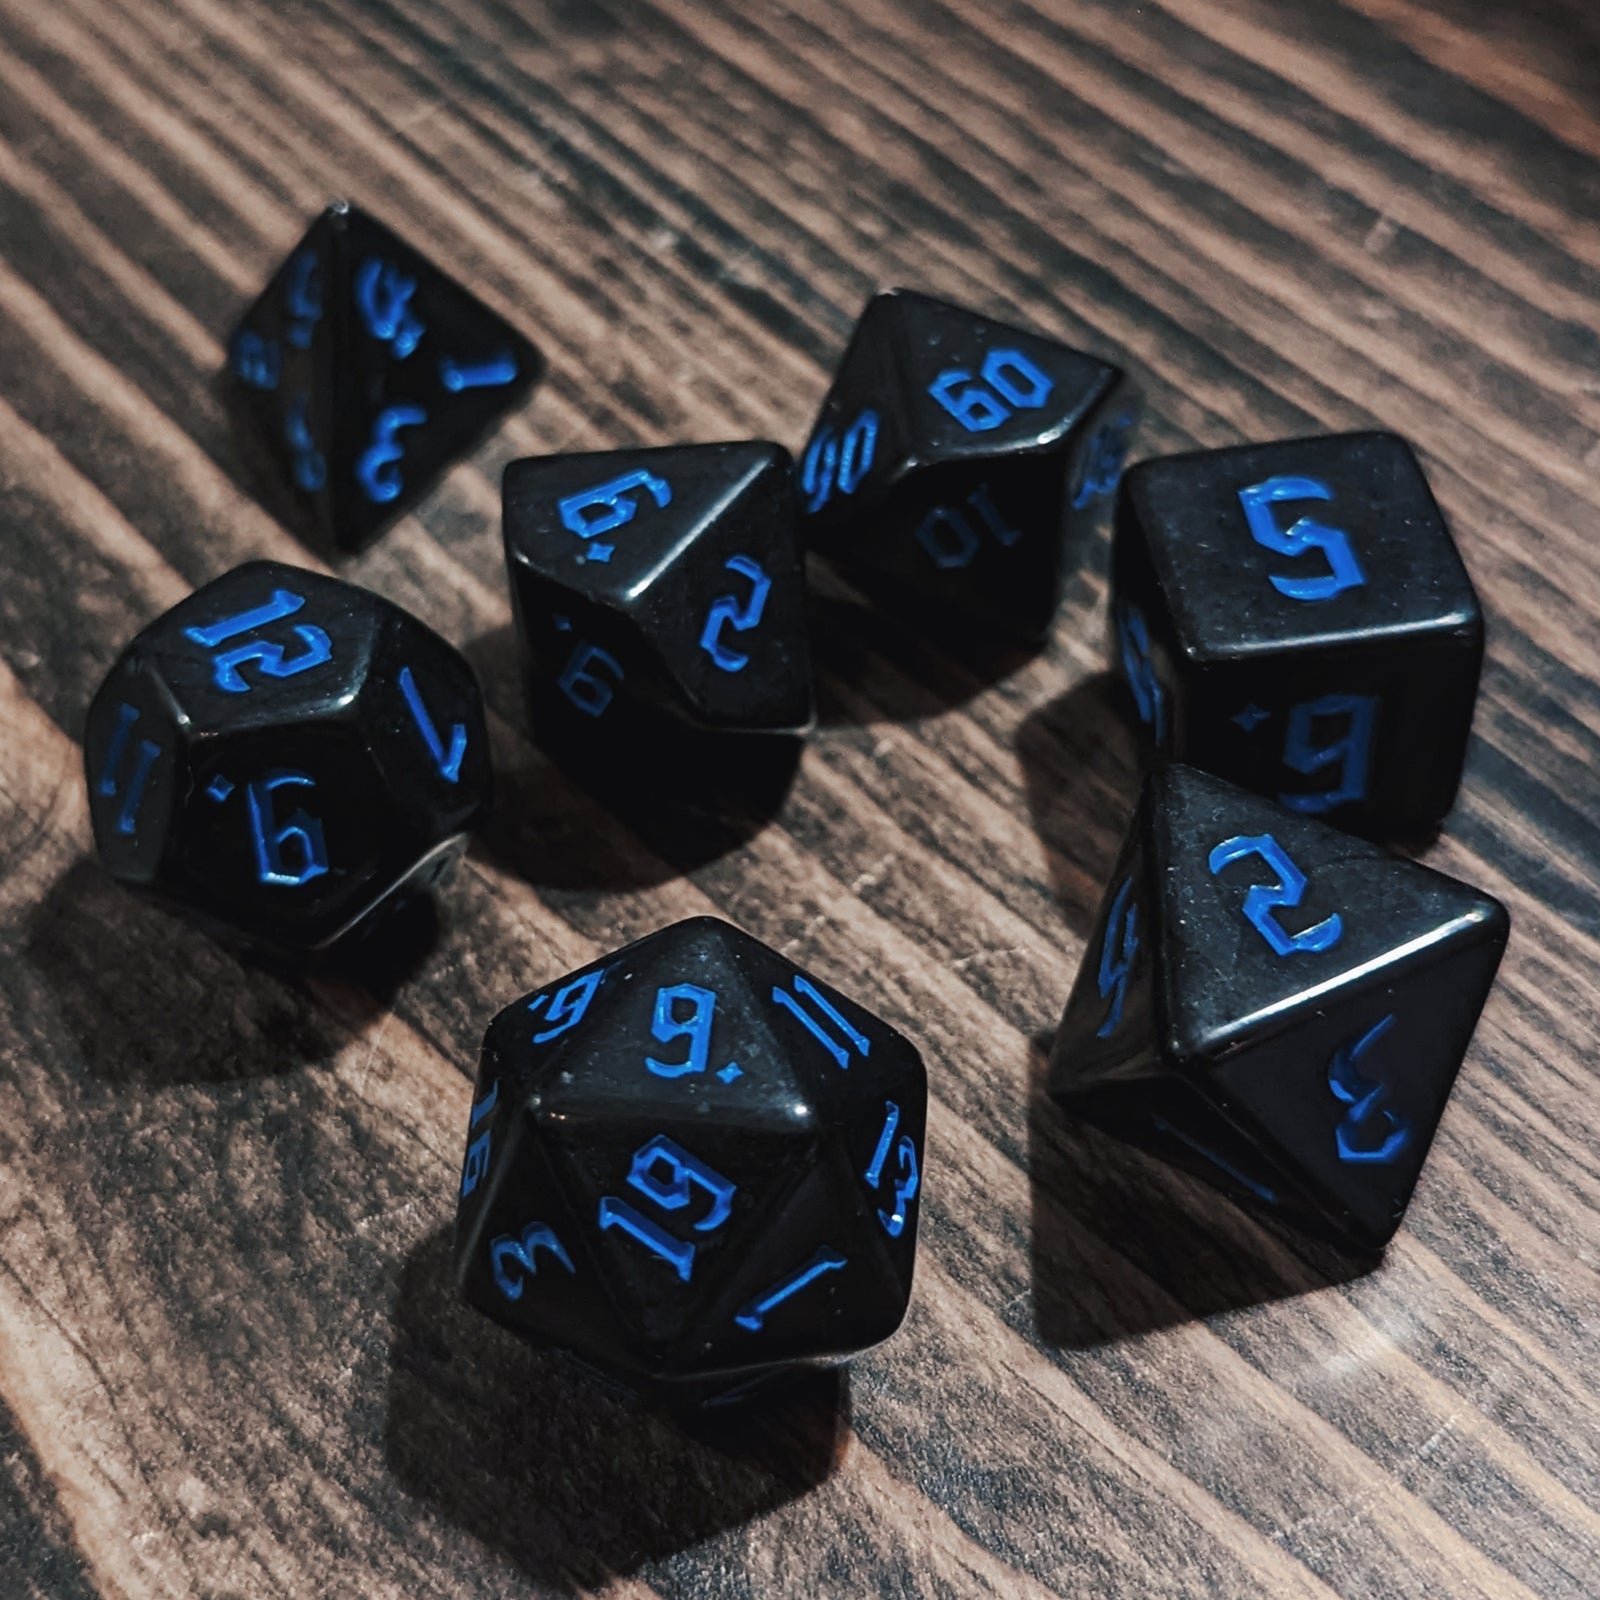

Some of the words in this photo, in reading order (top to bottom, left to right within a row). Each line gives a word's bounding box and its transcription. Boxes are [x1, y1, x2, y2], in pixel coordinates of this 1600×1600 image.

[356, 259, 425, 359] 4
[441, 353, 517, 393] 1
[928, 348, 1055, 433] 60
[1238, 475, 1367, 602] 5
[182, 588, 332, 694] 12
[699, 554, 772, 672] 2
[97, 703, 161, 835] 11
[1207, 833, 1344, 958] 2
[1098, 880, 1139, 1037] 4
[771, 974, 871, 1070] 11
[597, 1134, 737, 1283] 19
[864, 1100, 920, 1238] 13
[490, 1221, 576, 1300] 3
[733, 1245, 848, 1332] 1
